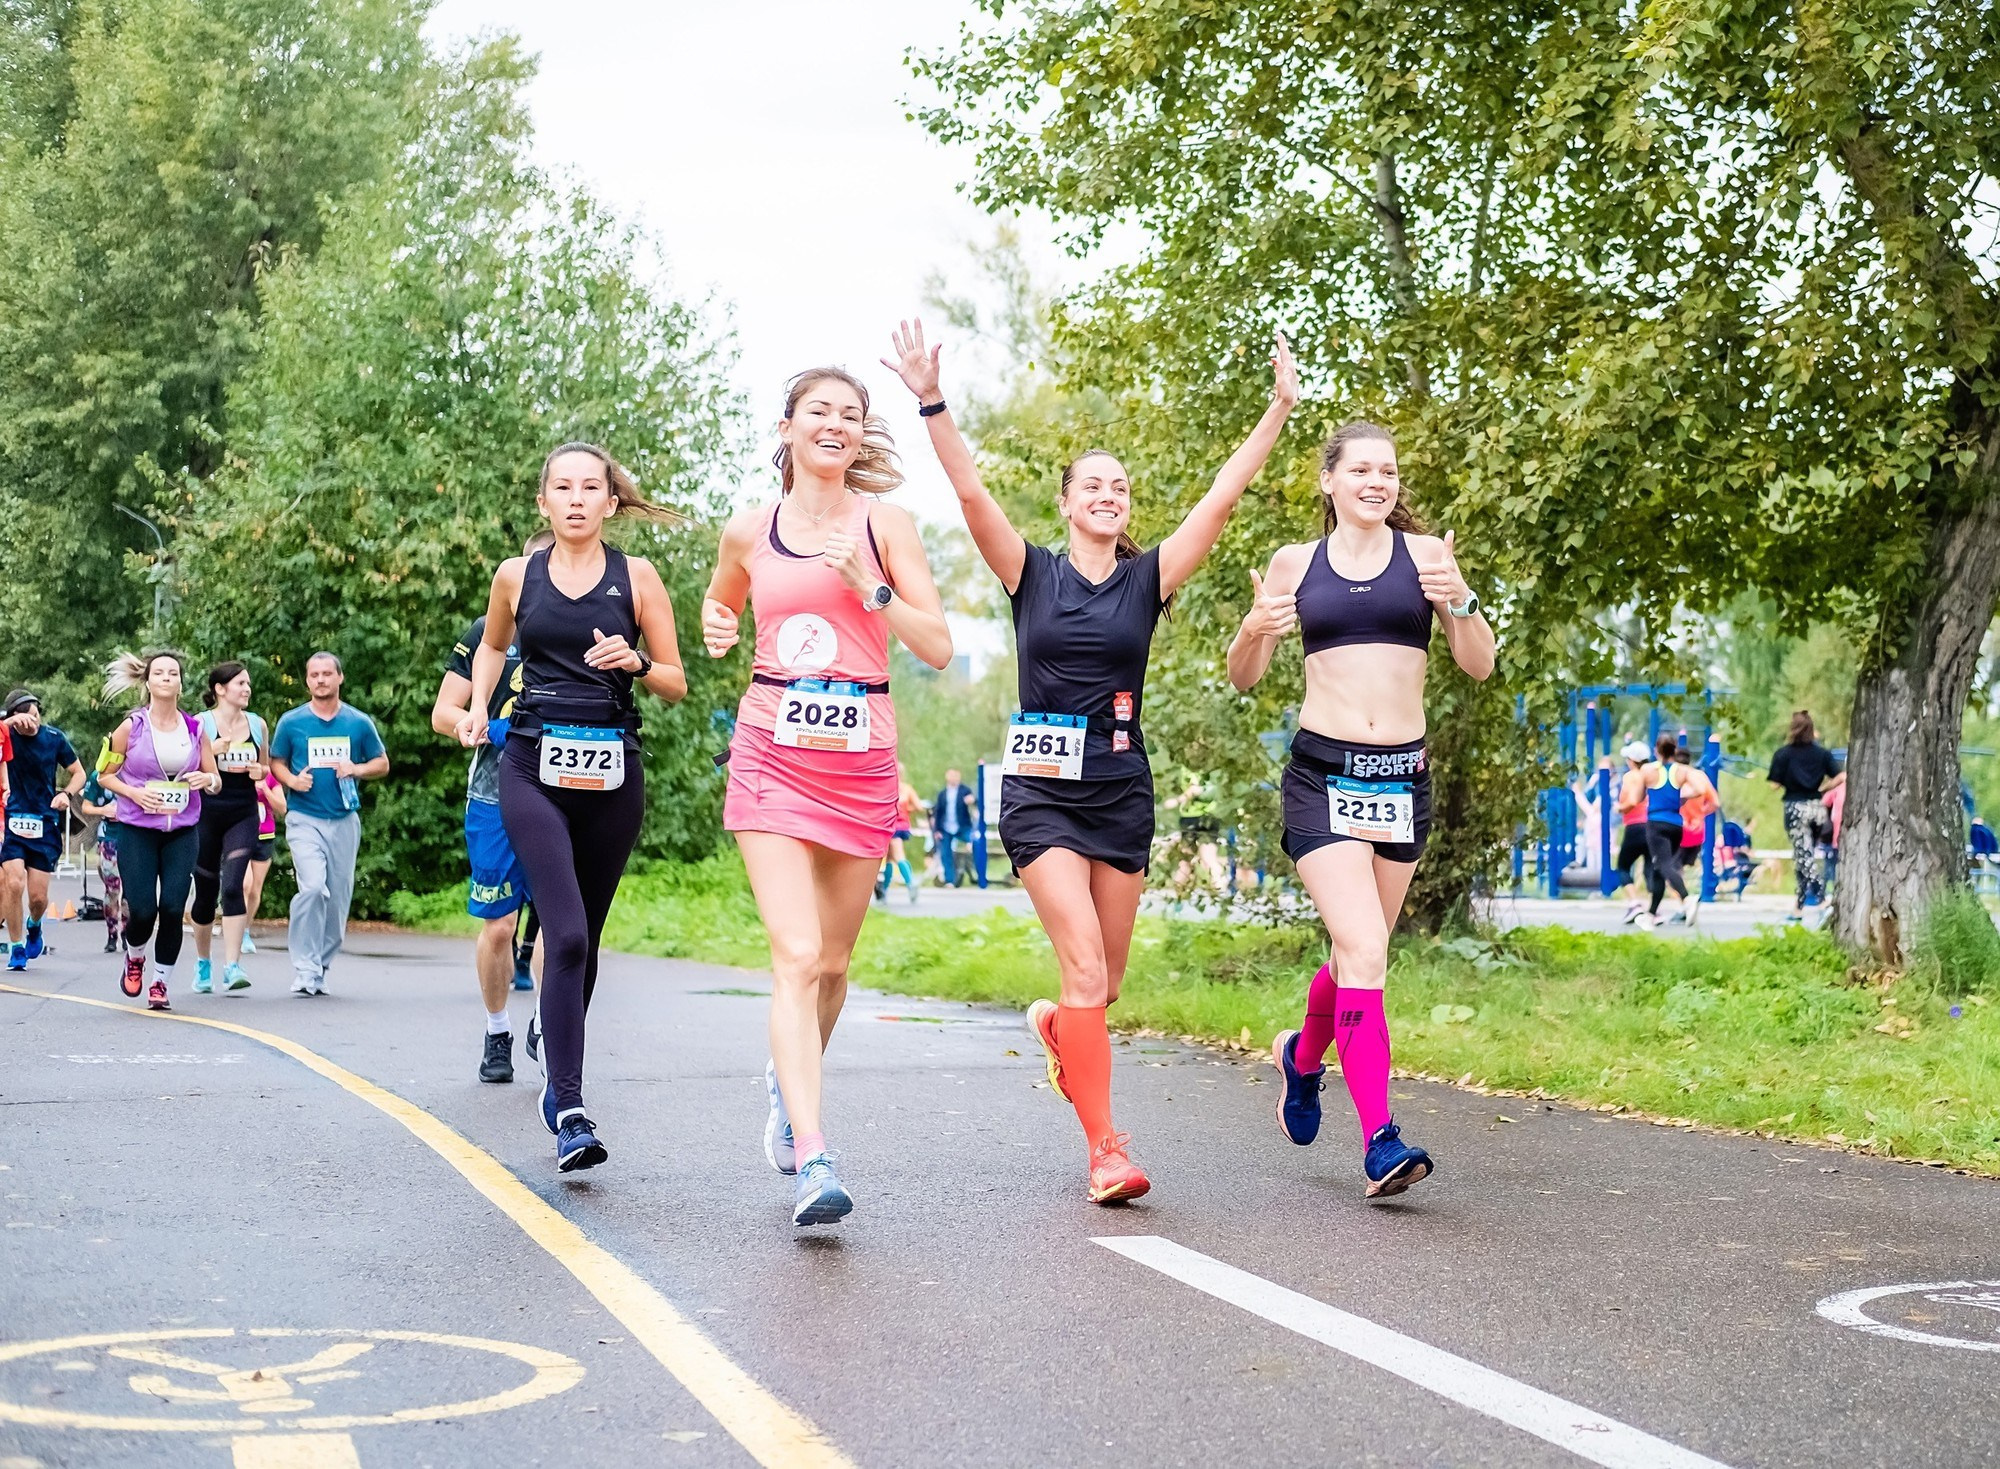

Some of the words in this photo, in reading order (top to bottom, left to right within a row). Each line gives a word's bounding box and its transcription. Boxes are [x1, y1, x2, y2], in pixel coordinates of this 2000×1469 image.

[786, 700, 858, 729] 2028
[1011, 733, 1070, 757] 2561
[548, 746, 612, 770] 2372
[1352, 762, 1417, 778] SPORT
[1336, 798, 1397, 823] 2213
[12, 821, 38, 831] 2112
